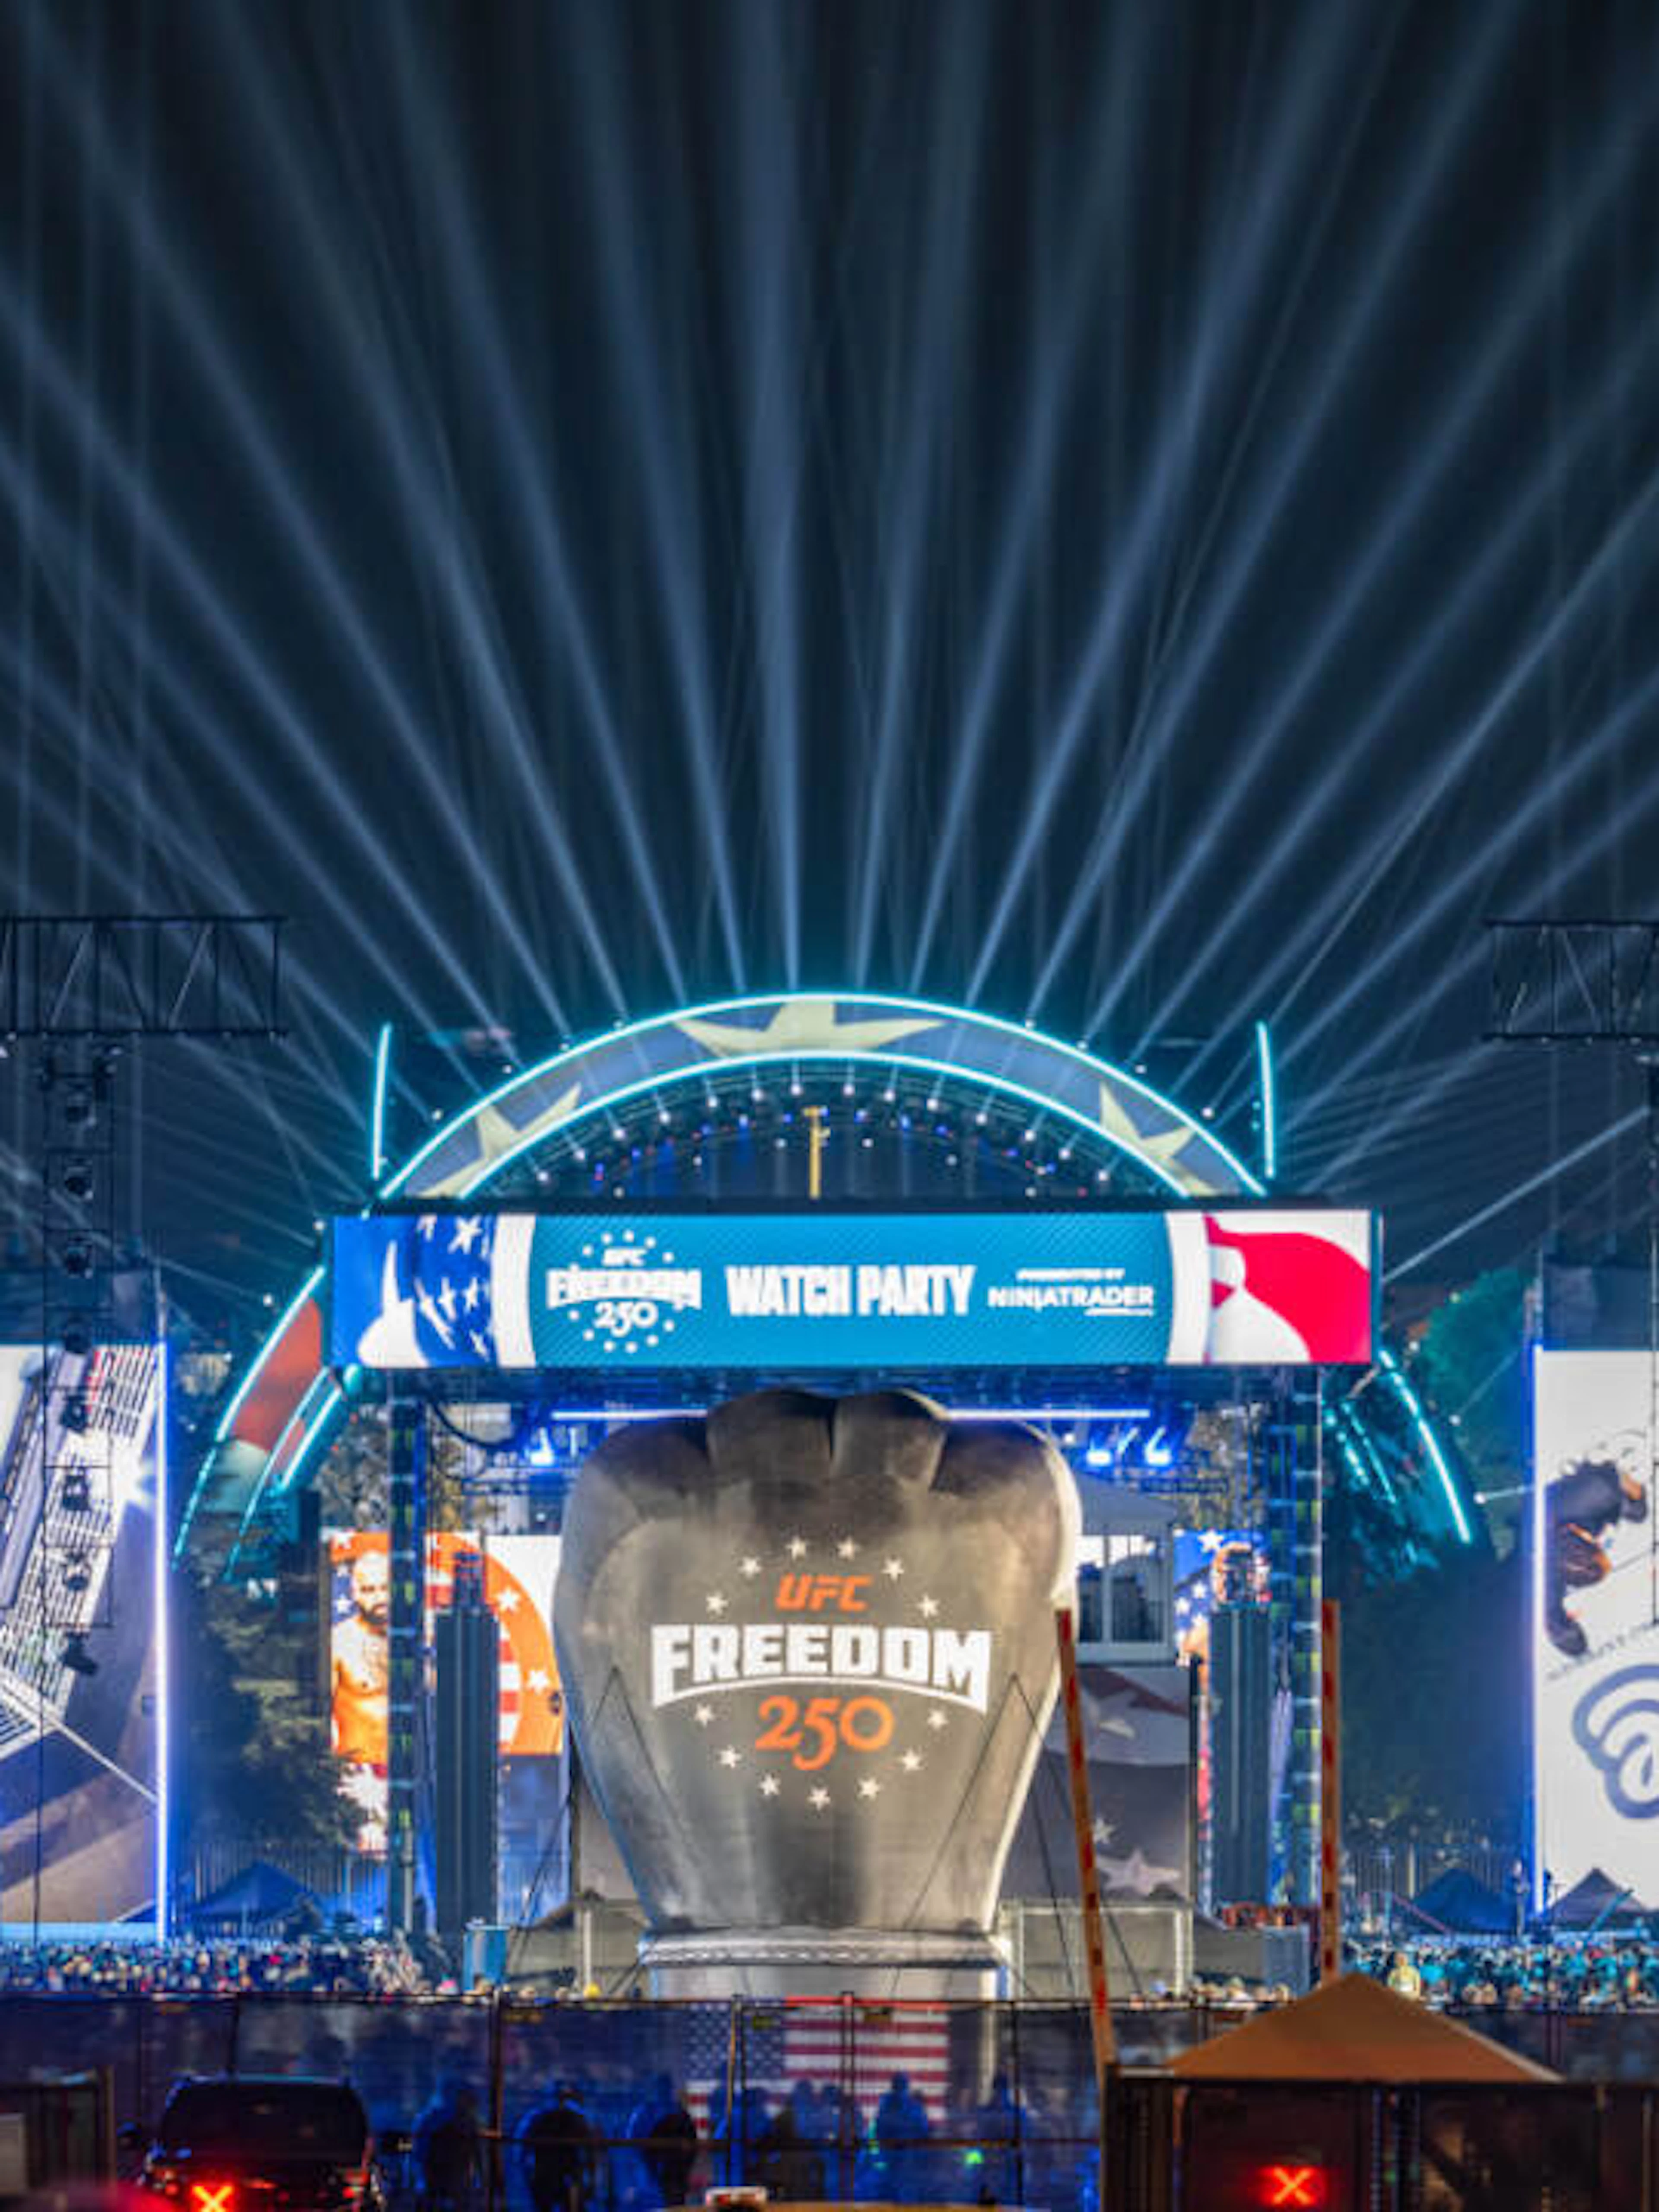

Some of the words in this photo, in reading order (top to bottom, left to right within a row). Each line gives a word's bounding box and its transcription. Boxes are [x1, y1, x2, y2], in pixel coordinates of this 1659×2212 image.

[726, 1265, 850, 1316] WATCH
[858, 1265, 976, 1316] PARTY
[988, 1285, 1154, 1312] NINJATRADER
[595, 1301, 658, 1336] 250
[775, 1574, 873, 1612] UFC
[650, 1624, 992, 1716] FREEDOM
[754, 1695, 895, 1771] 250
